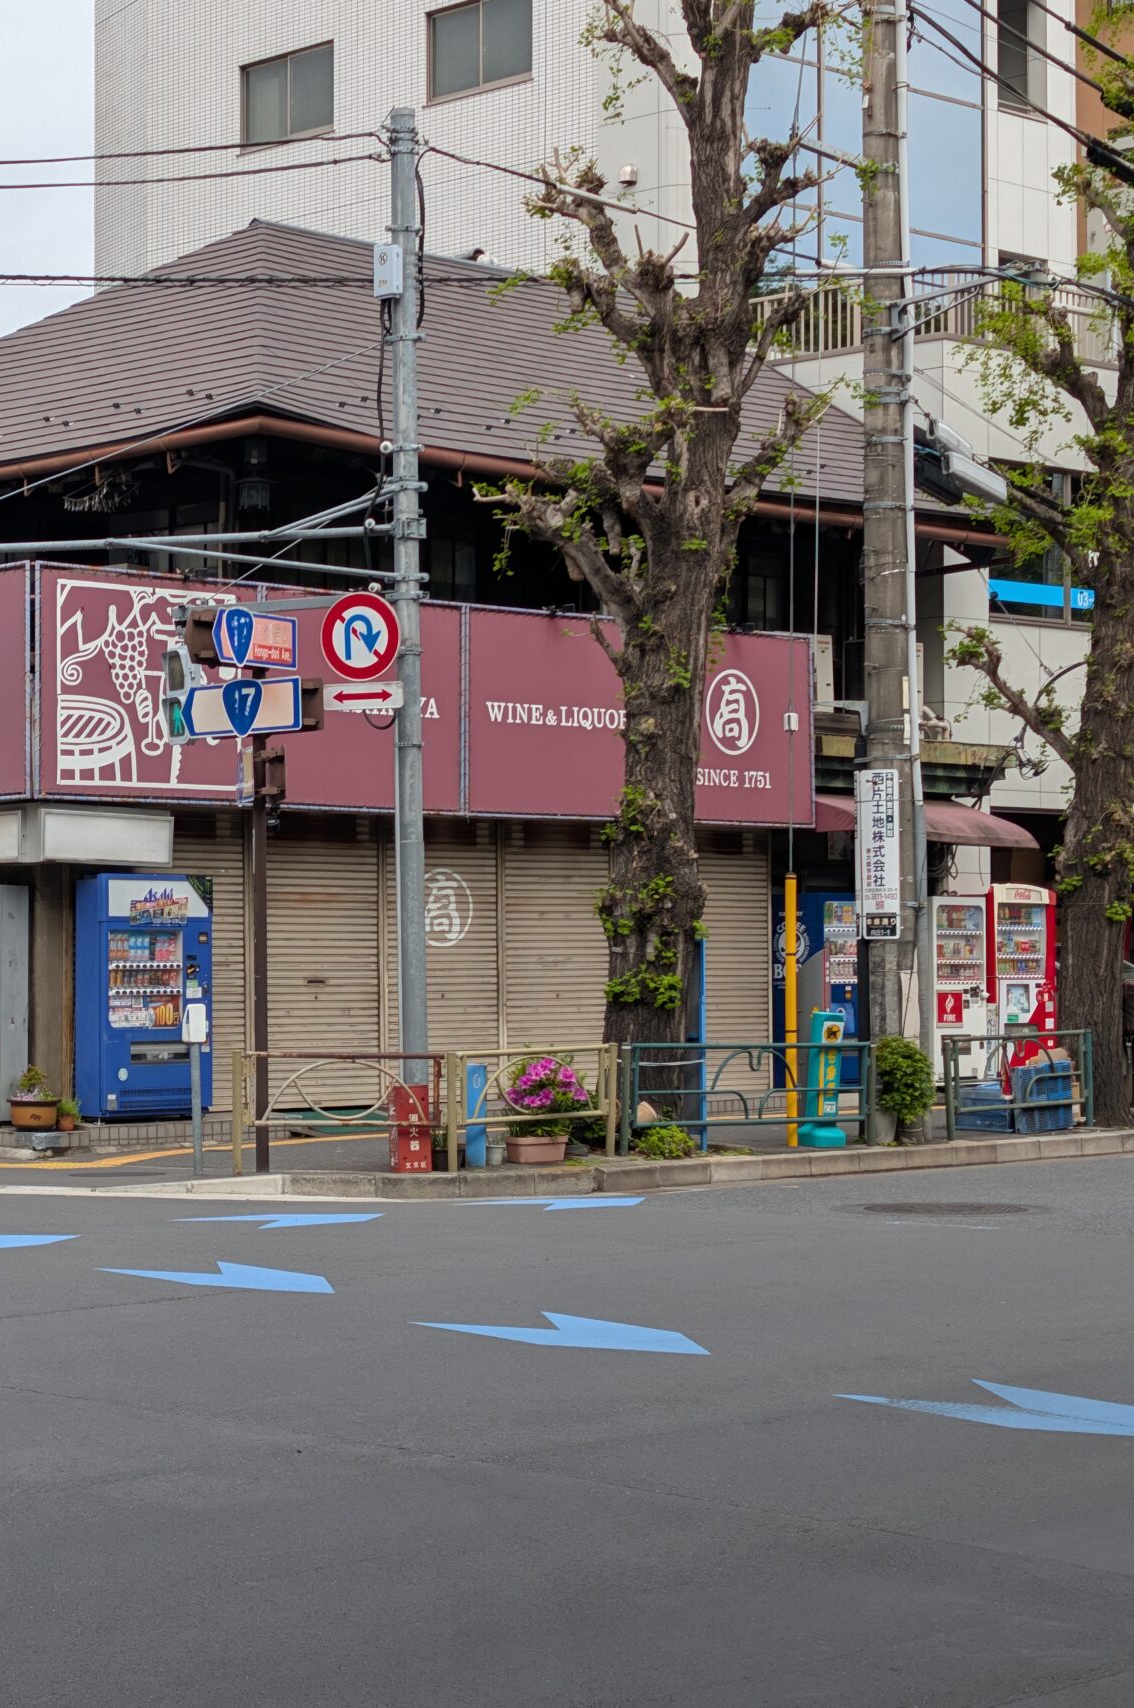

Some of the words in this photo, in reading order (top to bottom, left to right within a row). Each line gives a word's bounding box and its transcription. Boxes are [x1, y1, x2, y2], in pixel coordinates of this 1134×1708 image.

[254, 645, 280, 660] Hongo-dori
[695, 768, 739, 787] SINCE
[743, 771, 772, 789] 1751
[144, 888, 174, 903] Asahi
[943, 1014, 957, 1022] FIRE
